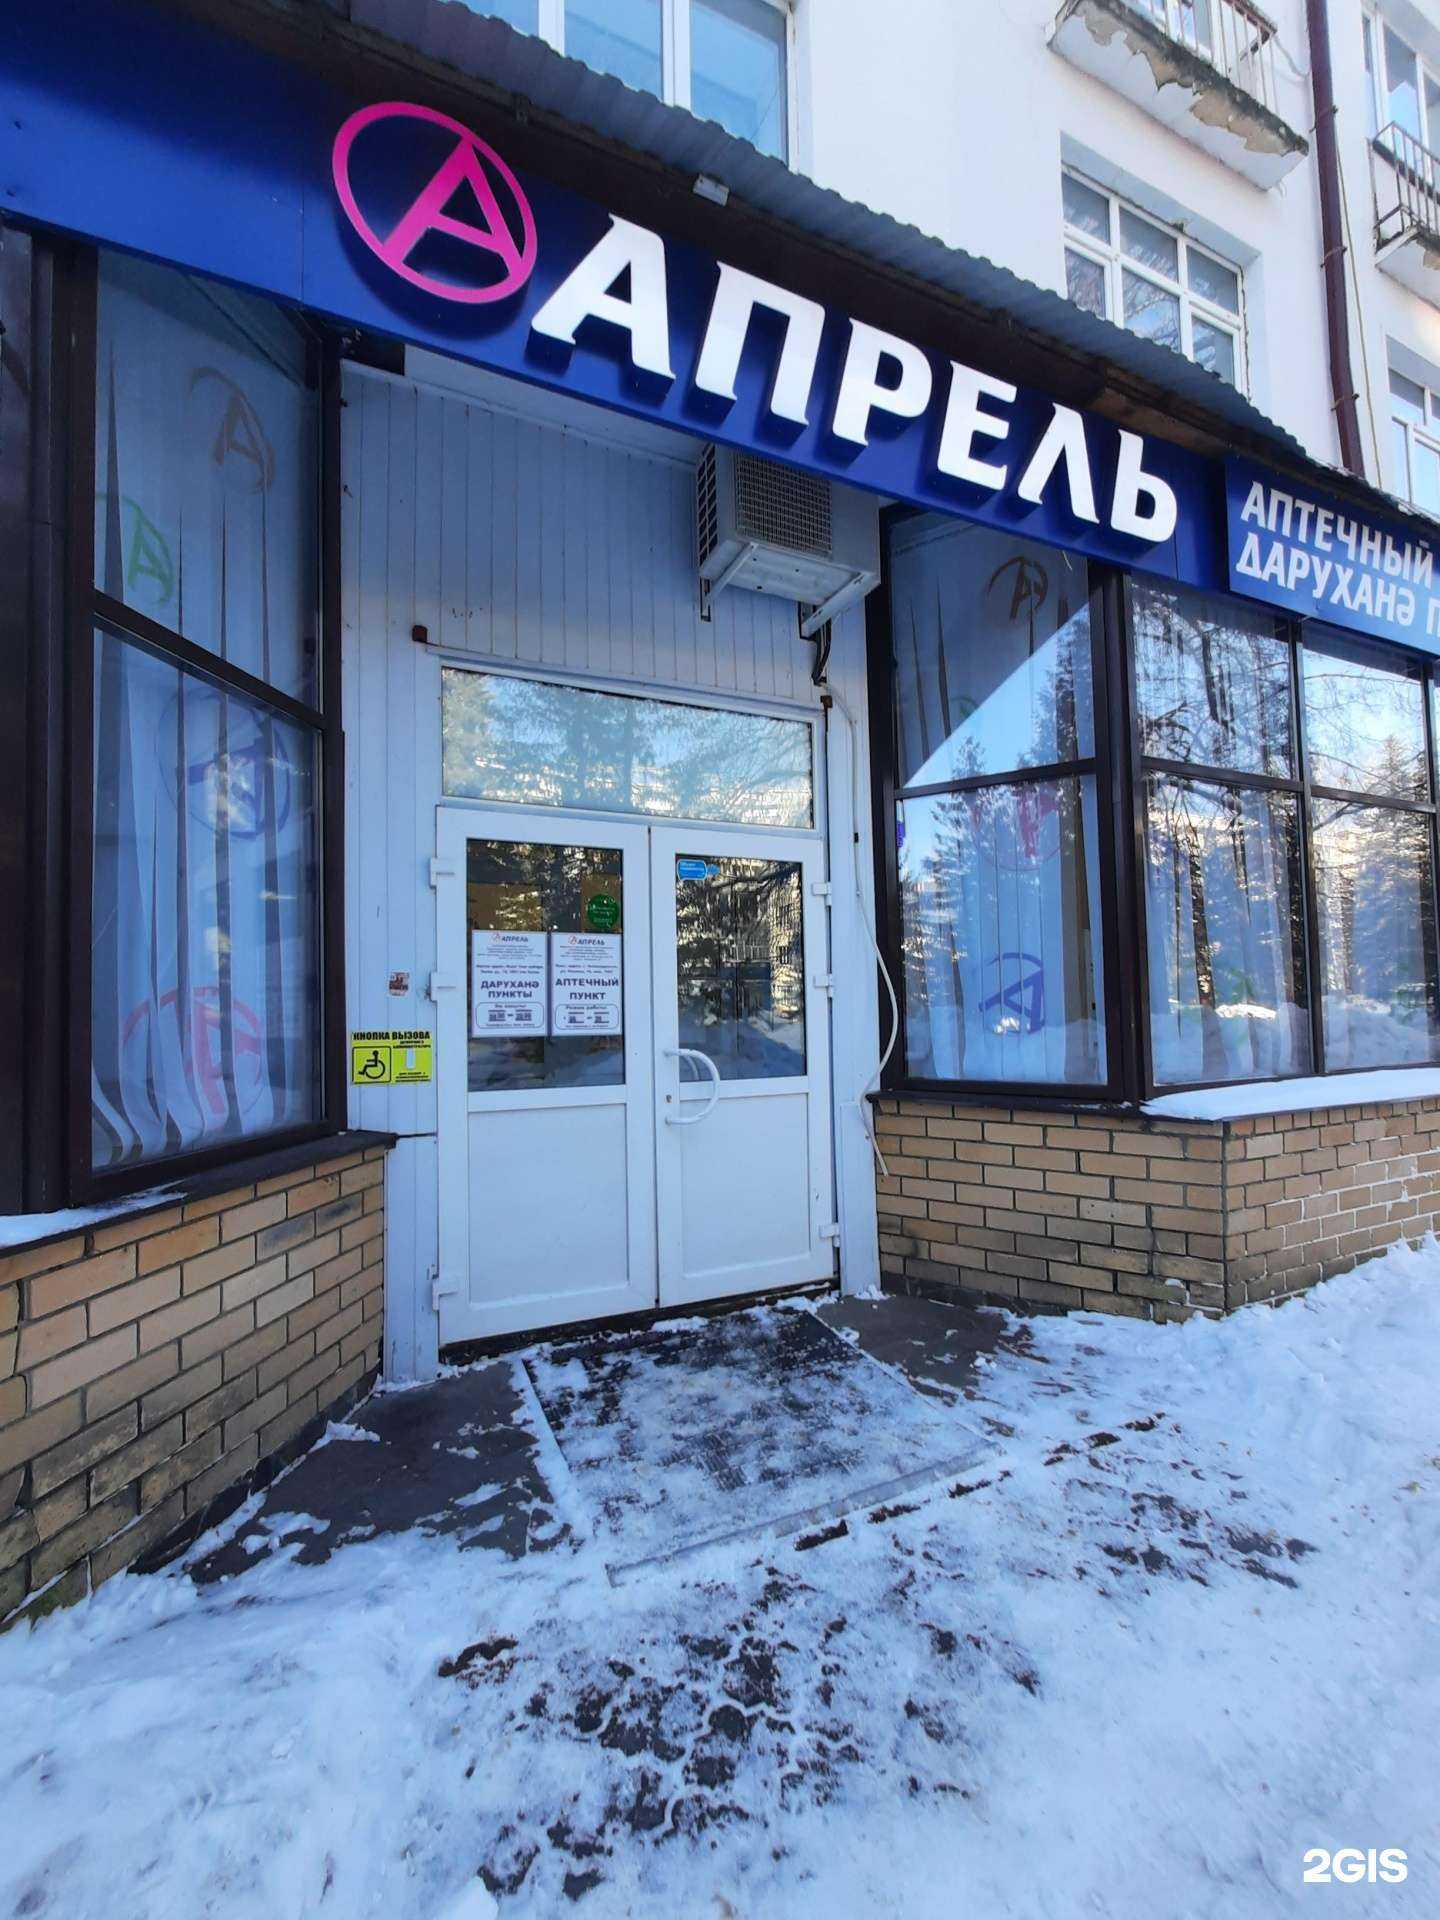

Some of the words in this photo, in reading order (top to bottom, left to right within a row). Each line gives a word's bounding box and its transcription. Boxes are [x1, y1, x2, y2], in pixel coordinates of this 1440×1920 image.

[530, 211, 1179, 543] АПРЕЛЬ
[1240, 479, 1433, 589] АПТЕЧНЫЙ
[1235, 532, 1415, 626] ДАРУХАНӘ
[577, 938, 606, 946] АПРЕЛЬ
[480, 980, 540, 990] ДАРУХАНӘ
[555, 976, 619, 987] АПТЕЧНЫЙ
[488, 990, 532, 999] ПУНКТЫ
[569, 992, 607, 1001] ПУНКТ
[353, 1031, 390, 1041] КНОПКА
[391, 1031, 431, 1041] ВЫЗОВА
